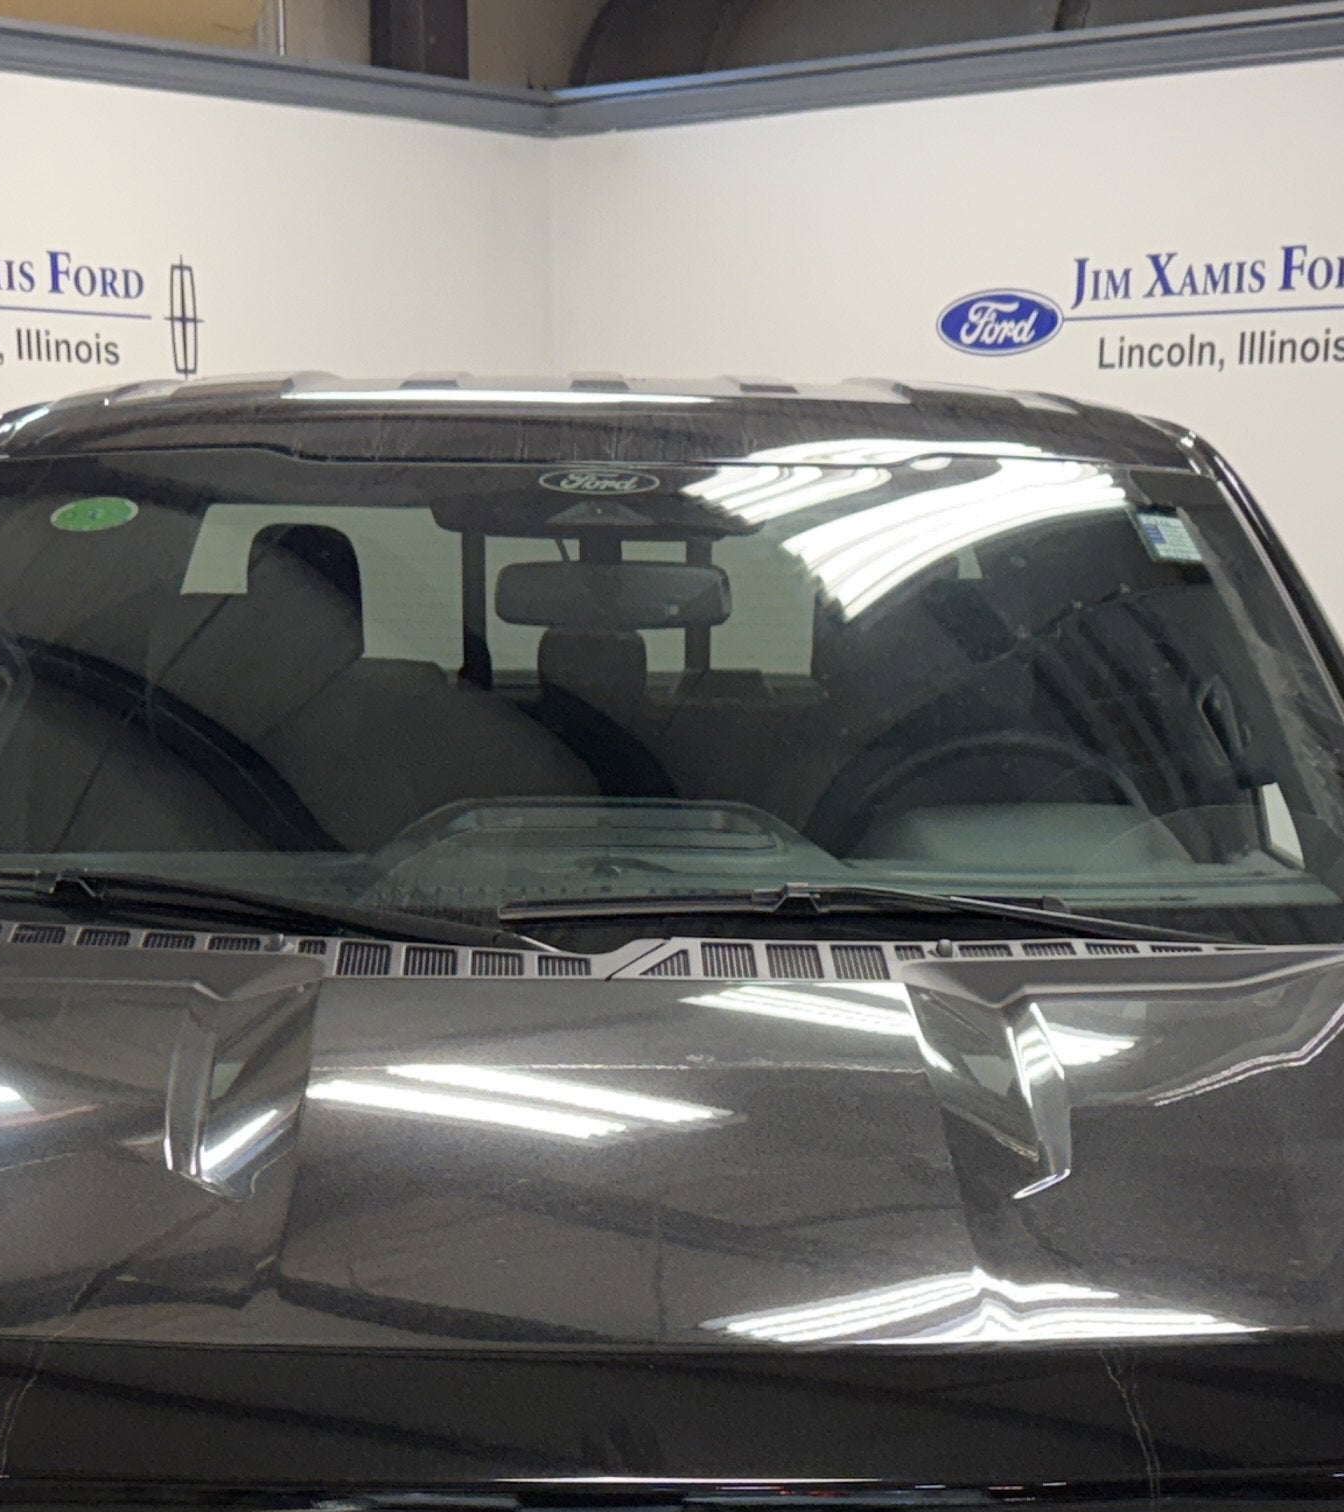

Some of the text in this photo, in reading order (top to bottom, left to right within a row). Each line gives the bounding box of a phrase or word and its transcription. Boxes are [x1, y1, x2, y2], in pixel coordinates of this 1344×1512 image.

[46, 250, 144, 300] FORD
[1071, 257, 1132, 309] JIM
[1145, 251, 1266, 298] XAMIS
[959, 299, 1036, 344] Ford
[16, 328, 120, 365] Illinois
[1097, 333, 1225, 371] Lincoln,
[560, 473, 639, 490] Ford
